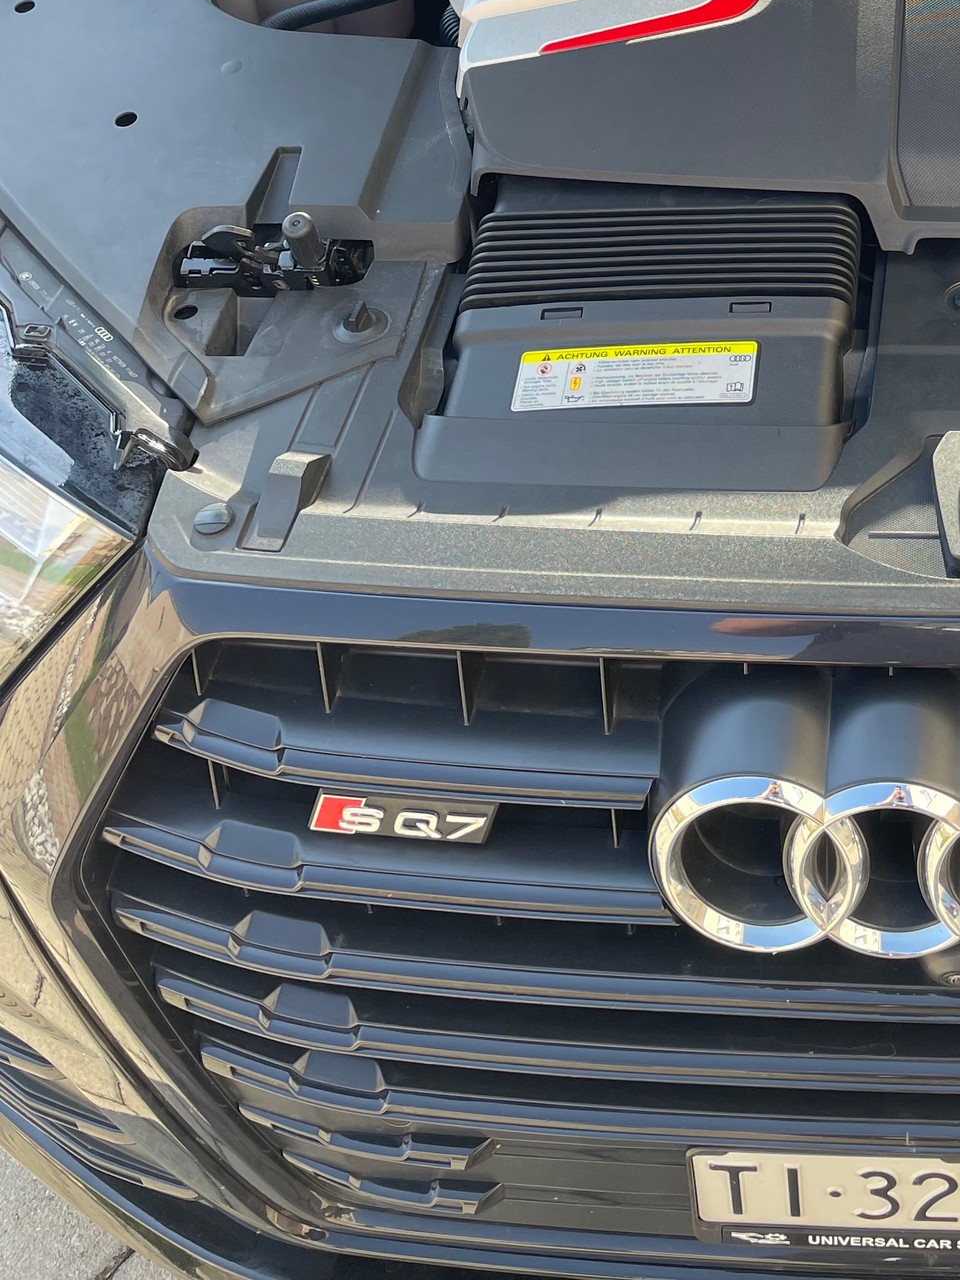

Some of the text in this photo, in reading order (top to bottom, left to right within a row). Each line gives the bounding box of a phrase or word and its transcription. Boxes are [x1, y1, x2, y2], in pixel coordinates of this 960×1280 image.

[556, 345, 732, 361] ACHTUNG WARNING ATTENTION
[807, 1234, 909, 1248] UNIVERSAL
[913, 1238, 952, 1249] CAR
